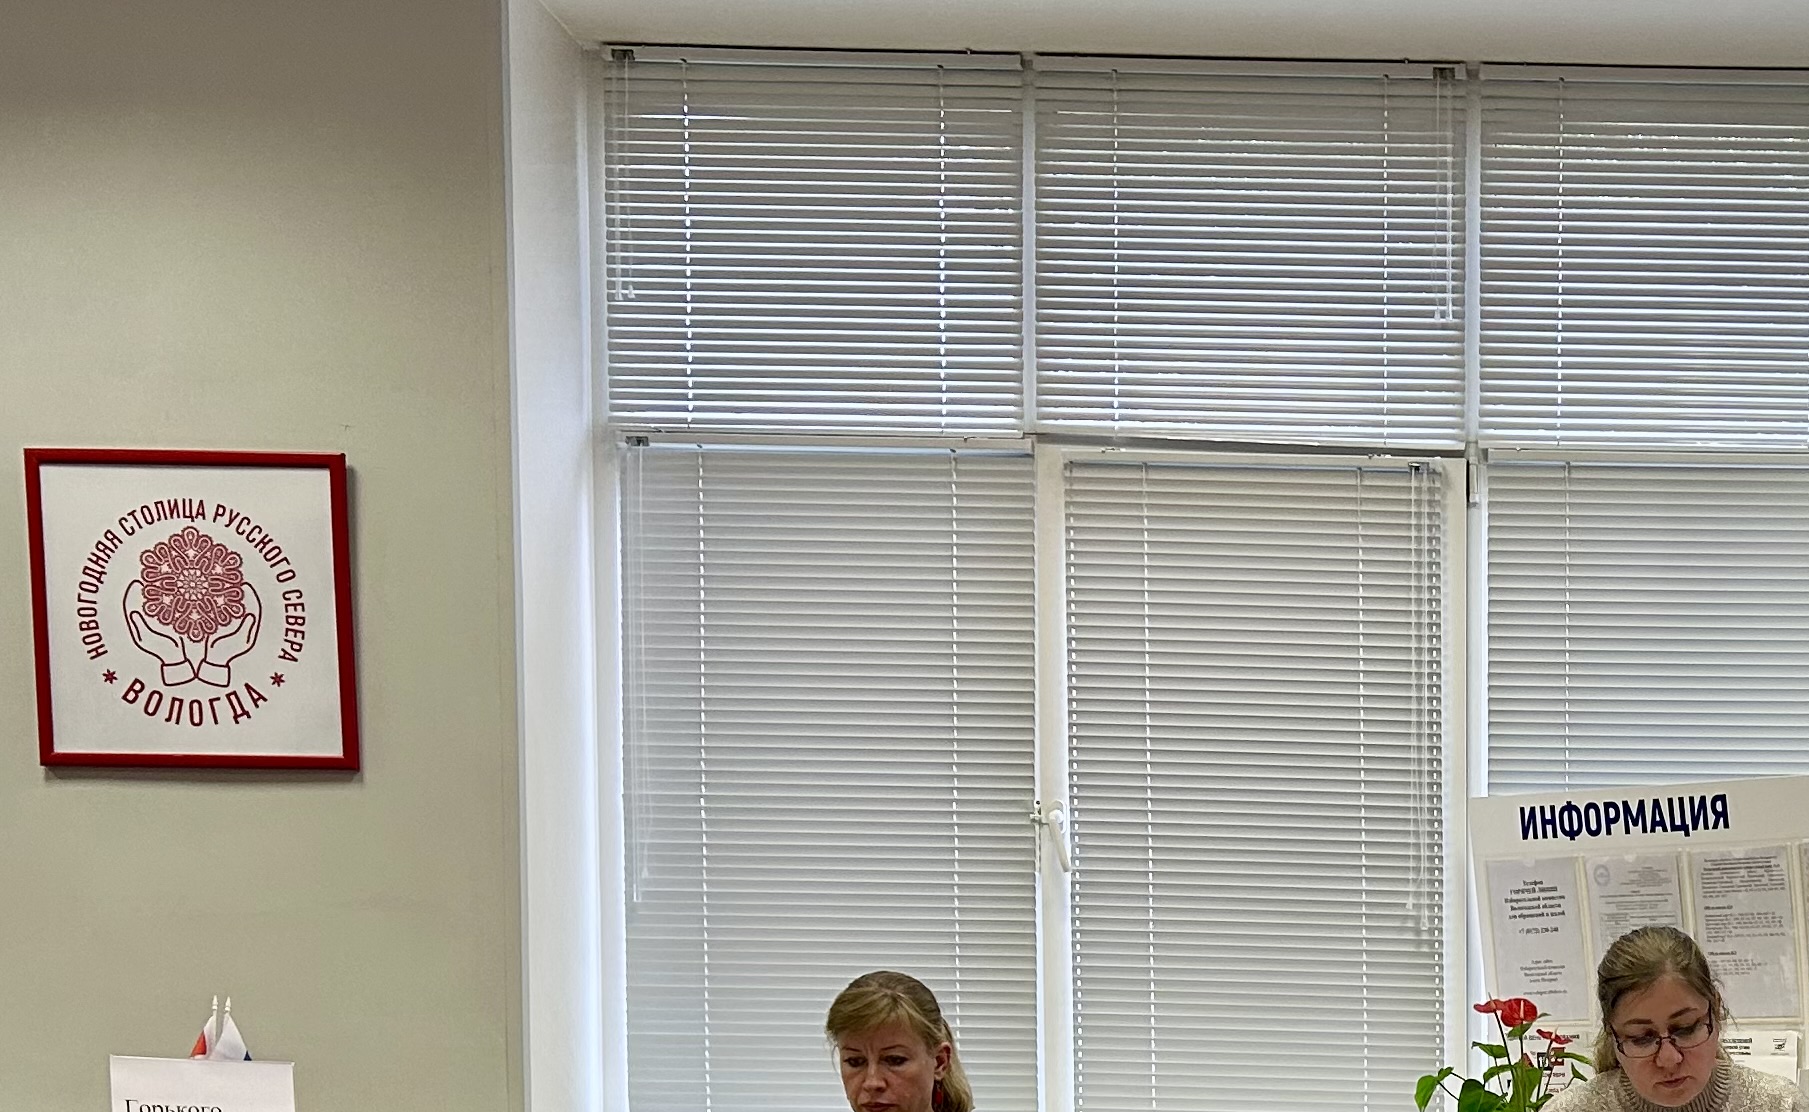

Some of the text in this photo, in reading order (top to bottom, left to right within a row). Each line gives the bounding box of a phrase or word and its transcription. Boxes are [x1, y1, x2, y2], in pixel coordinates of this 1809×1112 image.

[77, 498, 306, 662] НОВОГОДНЯЯ СТОЛИЦА РУССКОГО СЕВЕРА
[121, 678, 268, 726] ВОЛОГДА
[1519, 794, 1730, 841] ИНФОРМАЦИЯ
